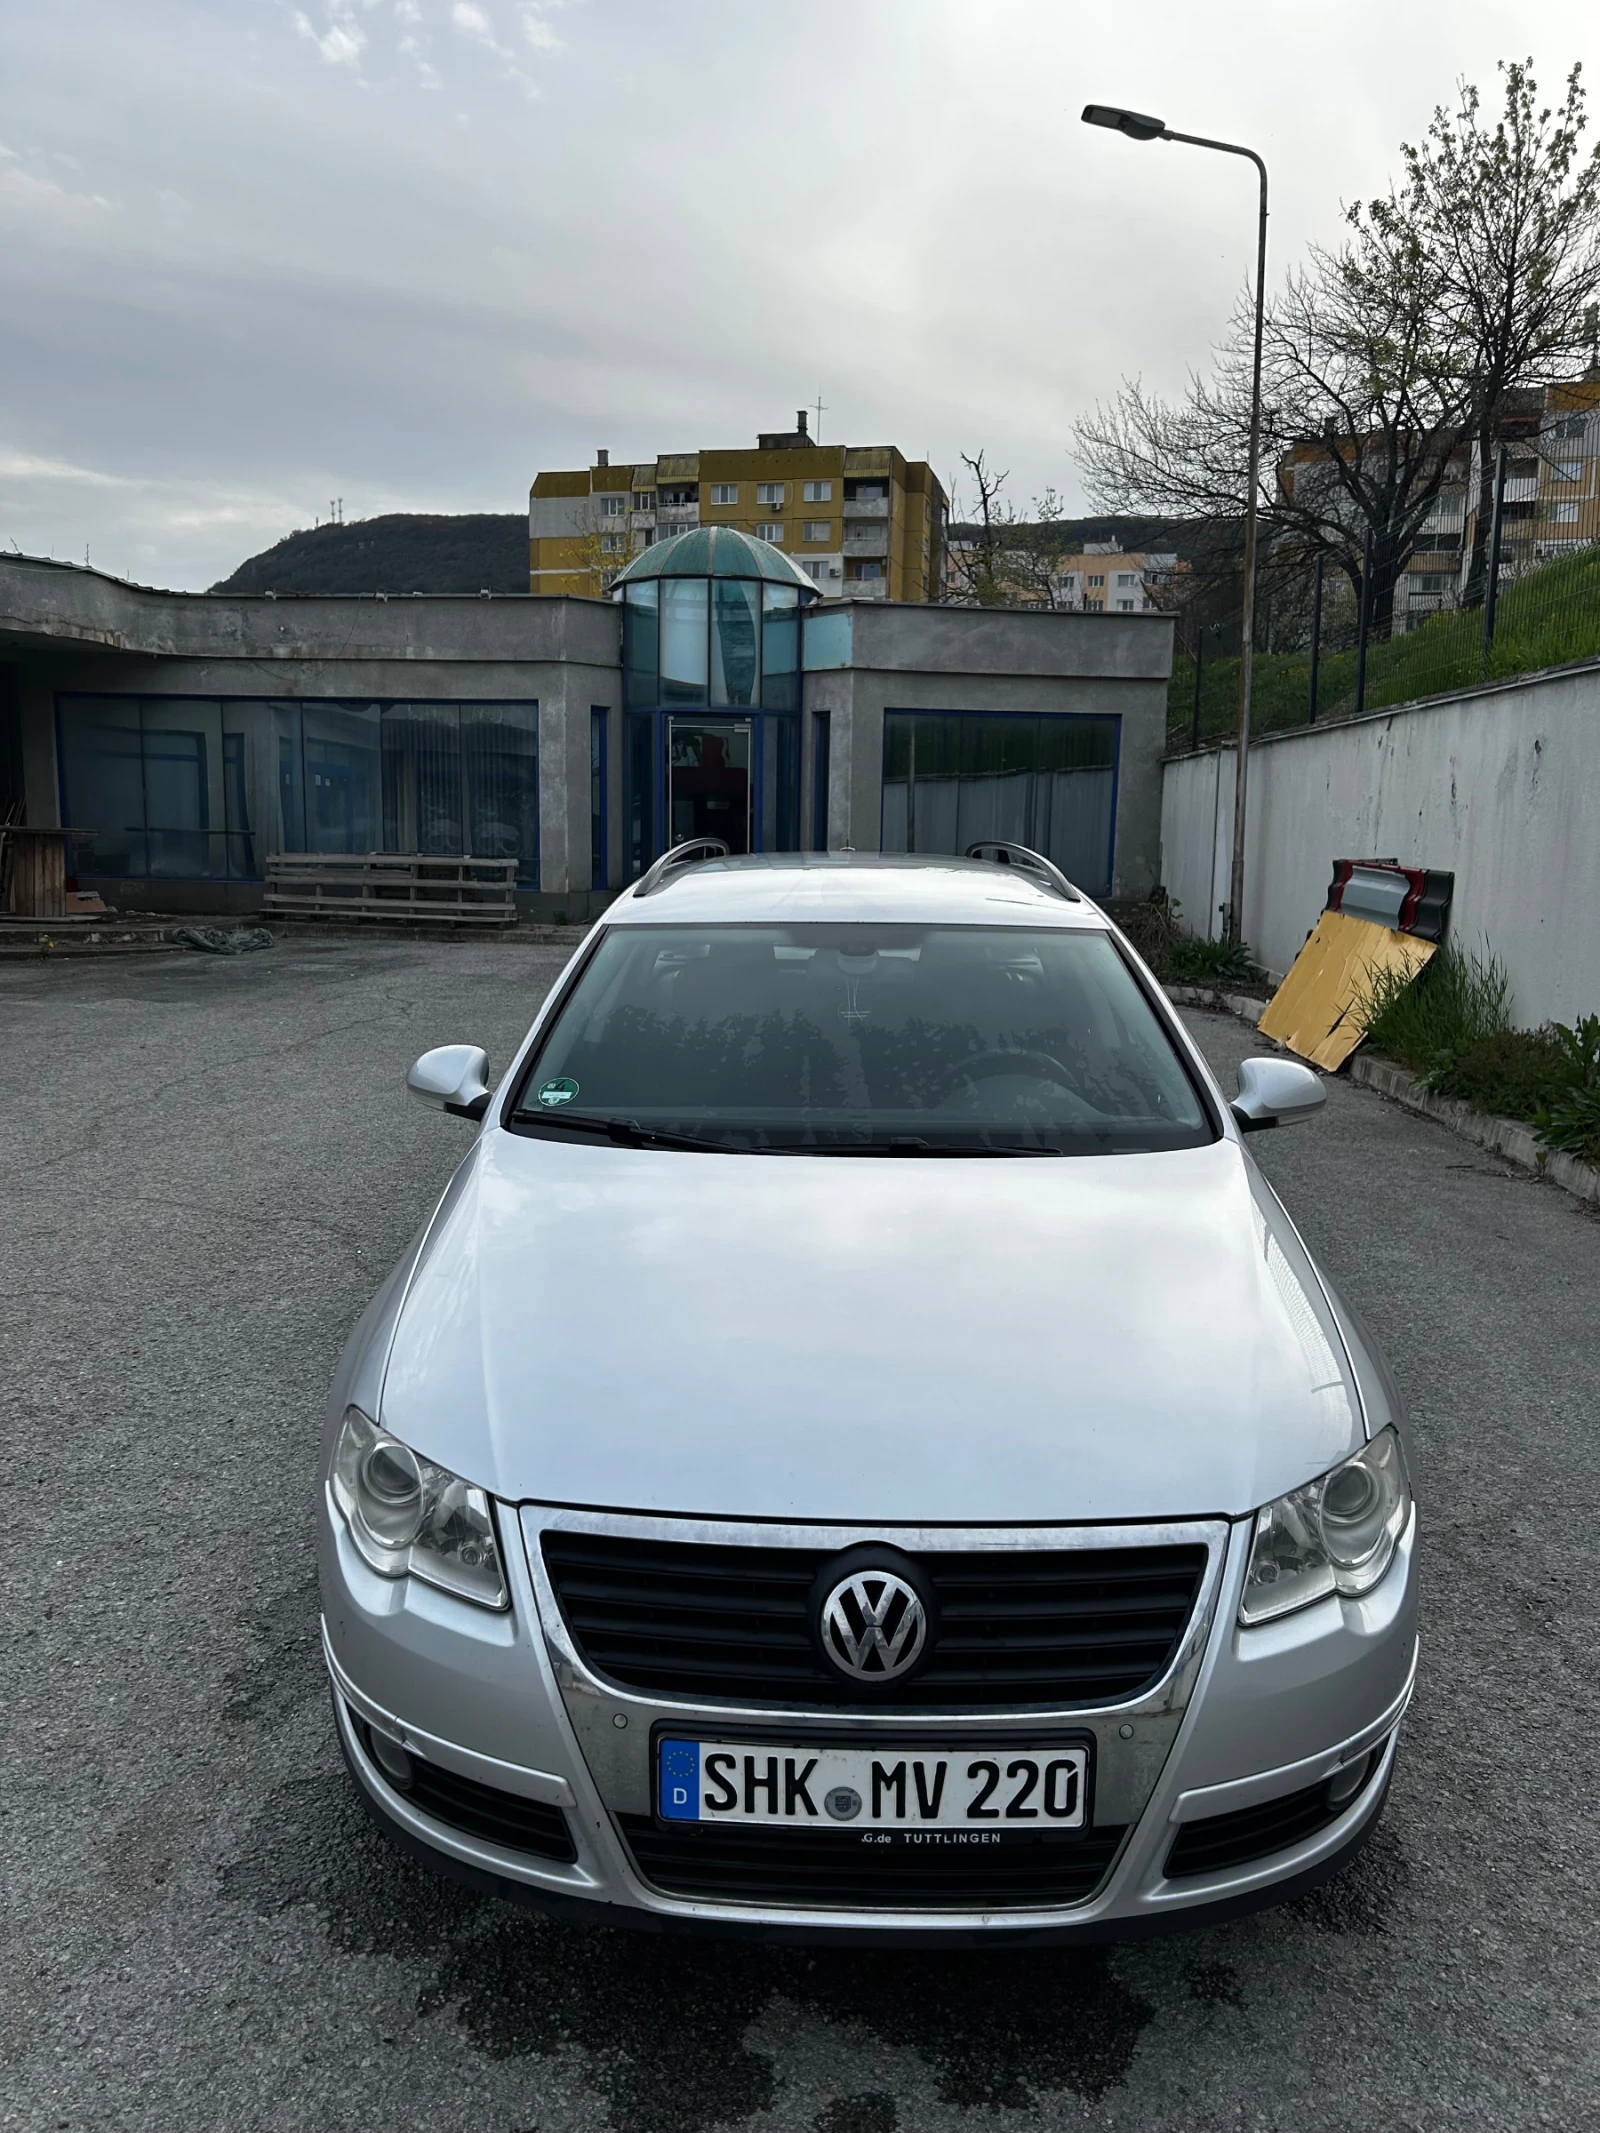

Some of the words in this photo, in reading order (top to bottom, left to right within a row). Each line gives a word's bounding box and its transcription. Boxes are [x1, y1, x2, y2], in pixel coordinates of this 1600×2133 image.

[821, 1570, 926, 1682] VW
[673, 1787, 688, 1805] D
[704, 1753, 819, 1816] SHK
[871, 1760, 948, 1819] MV
[966, 1759, 1079, 1819] 220
[903, 1833, 1001, 1843] TUTTLINGEN
